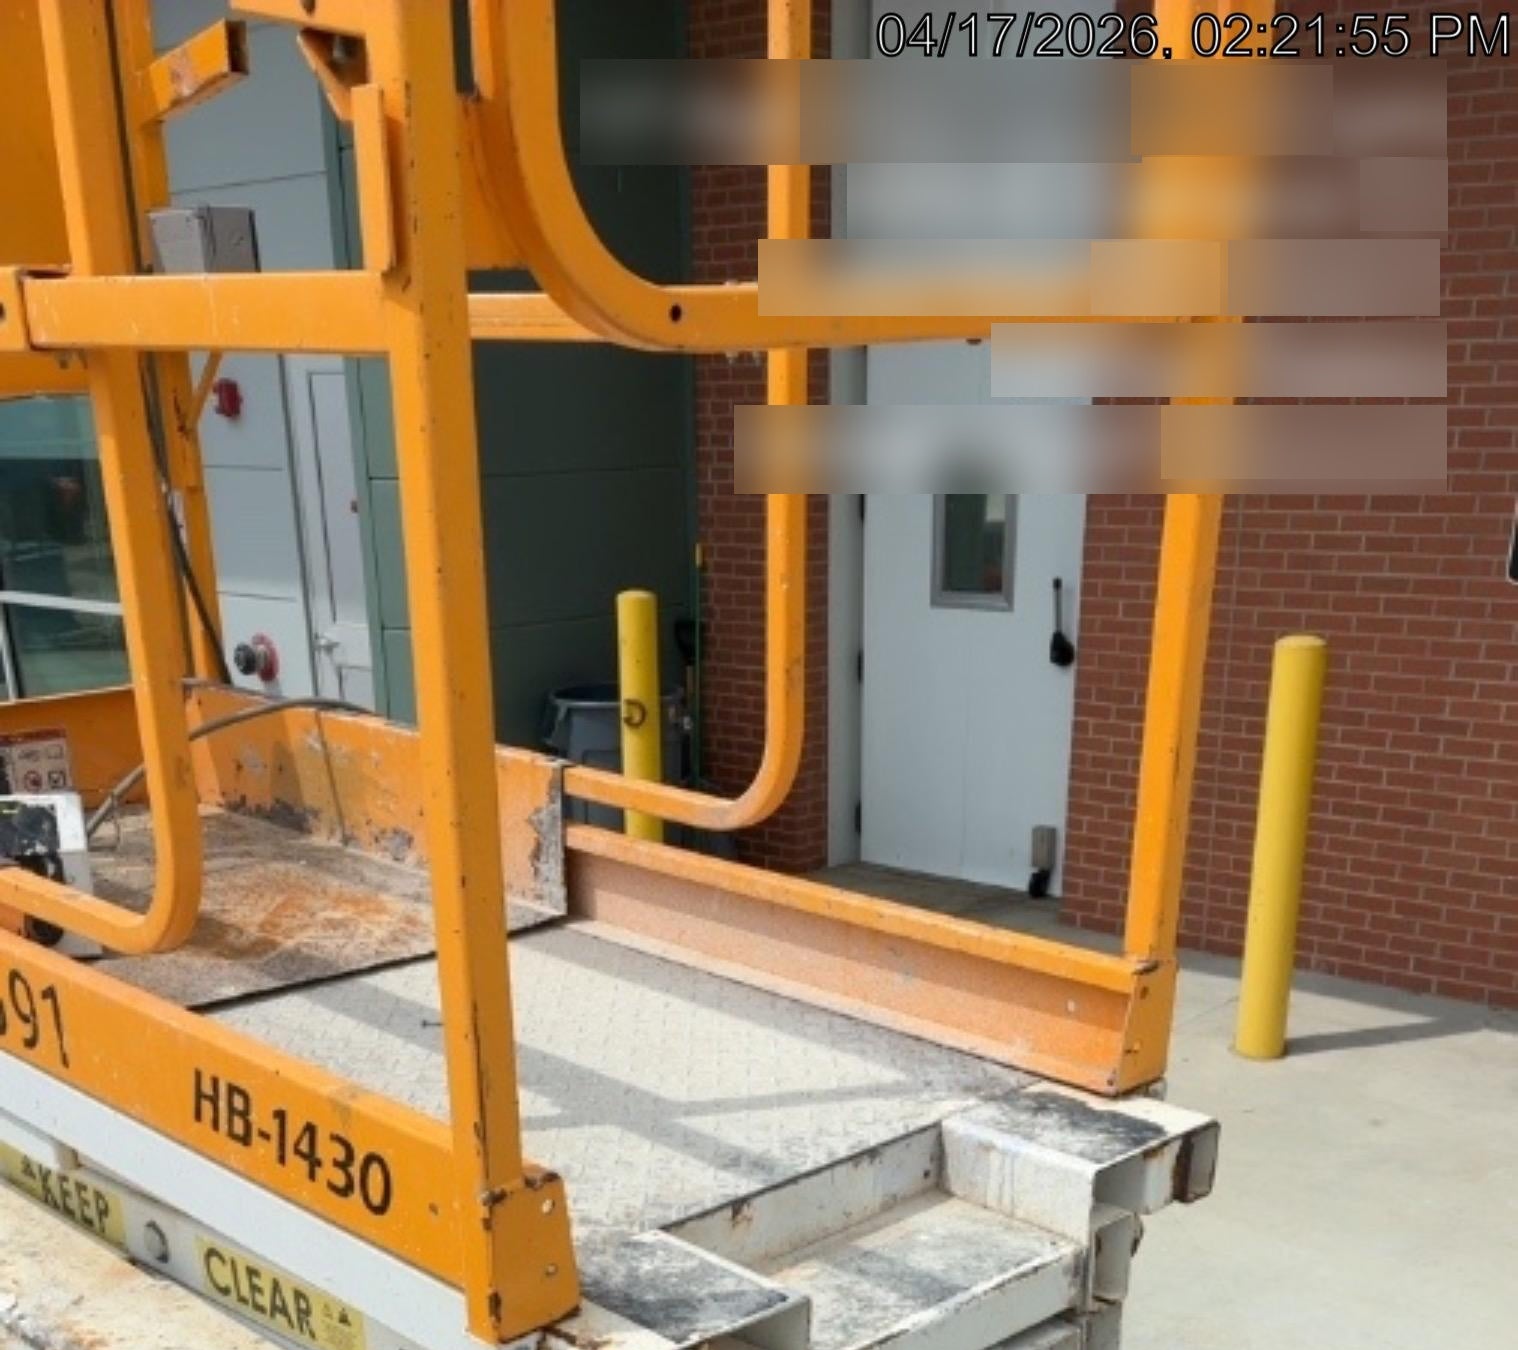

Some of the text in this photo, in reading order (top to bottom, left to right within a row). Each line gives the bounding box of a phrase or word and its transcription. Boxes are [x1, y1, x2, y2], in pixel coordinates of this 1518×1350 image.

[0, 968, 70, 1069] 91
[193, 1068, 392, 1216] HB-1430
[39, 1163, 109, 1236] KEEP
[203, 1246, 317, 1340] CLEAR
